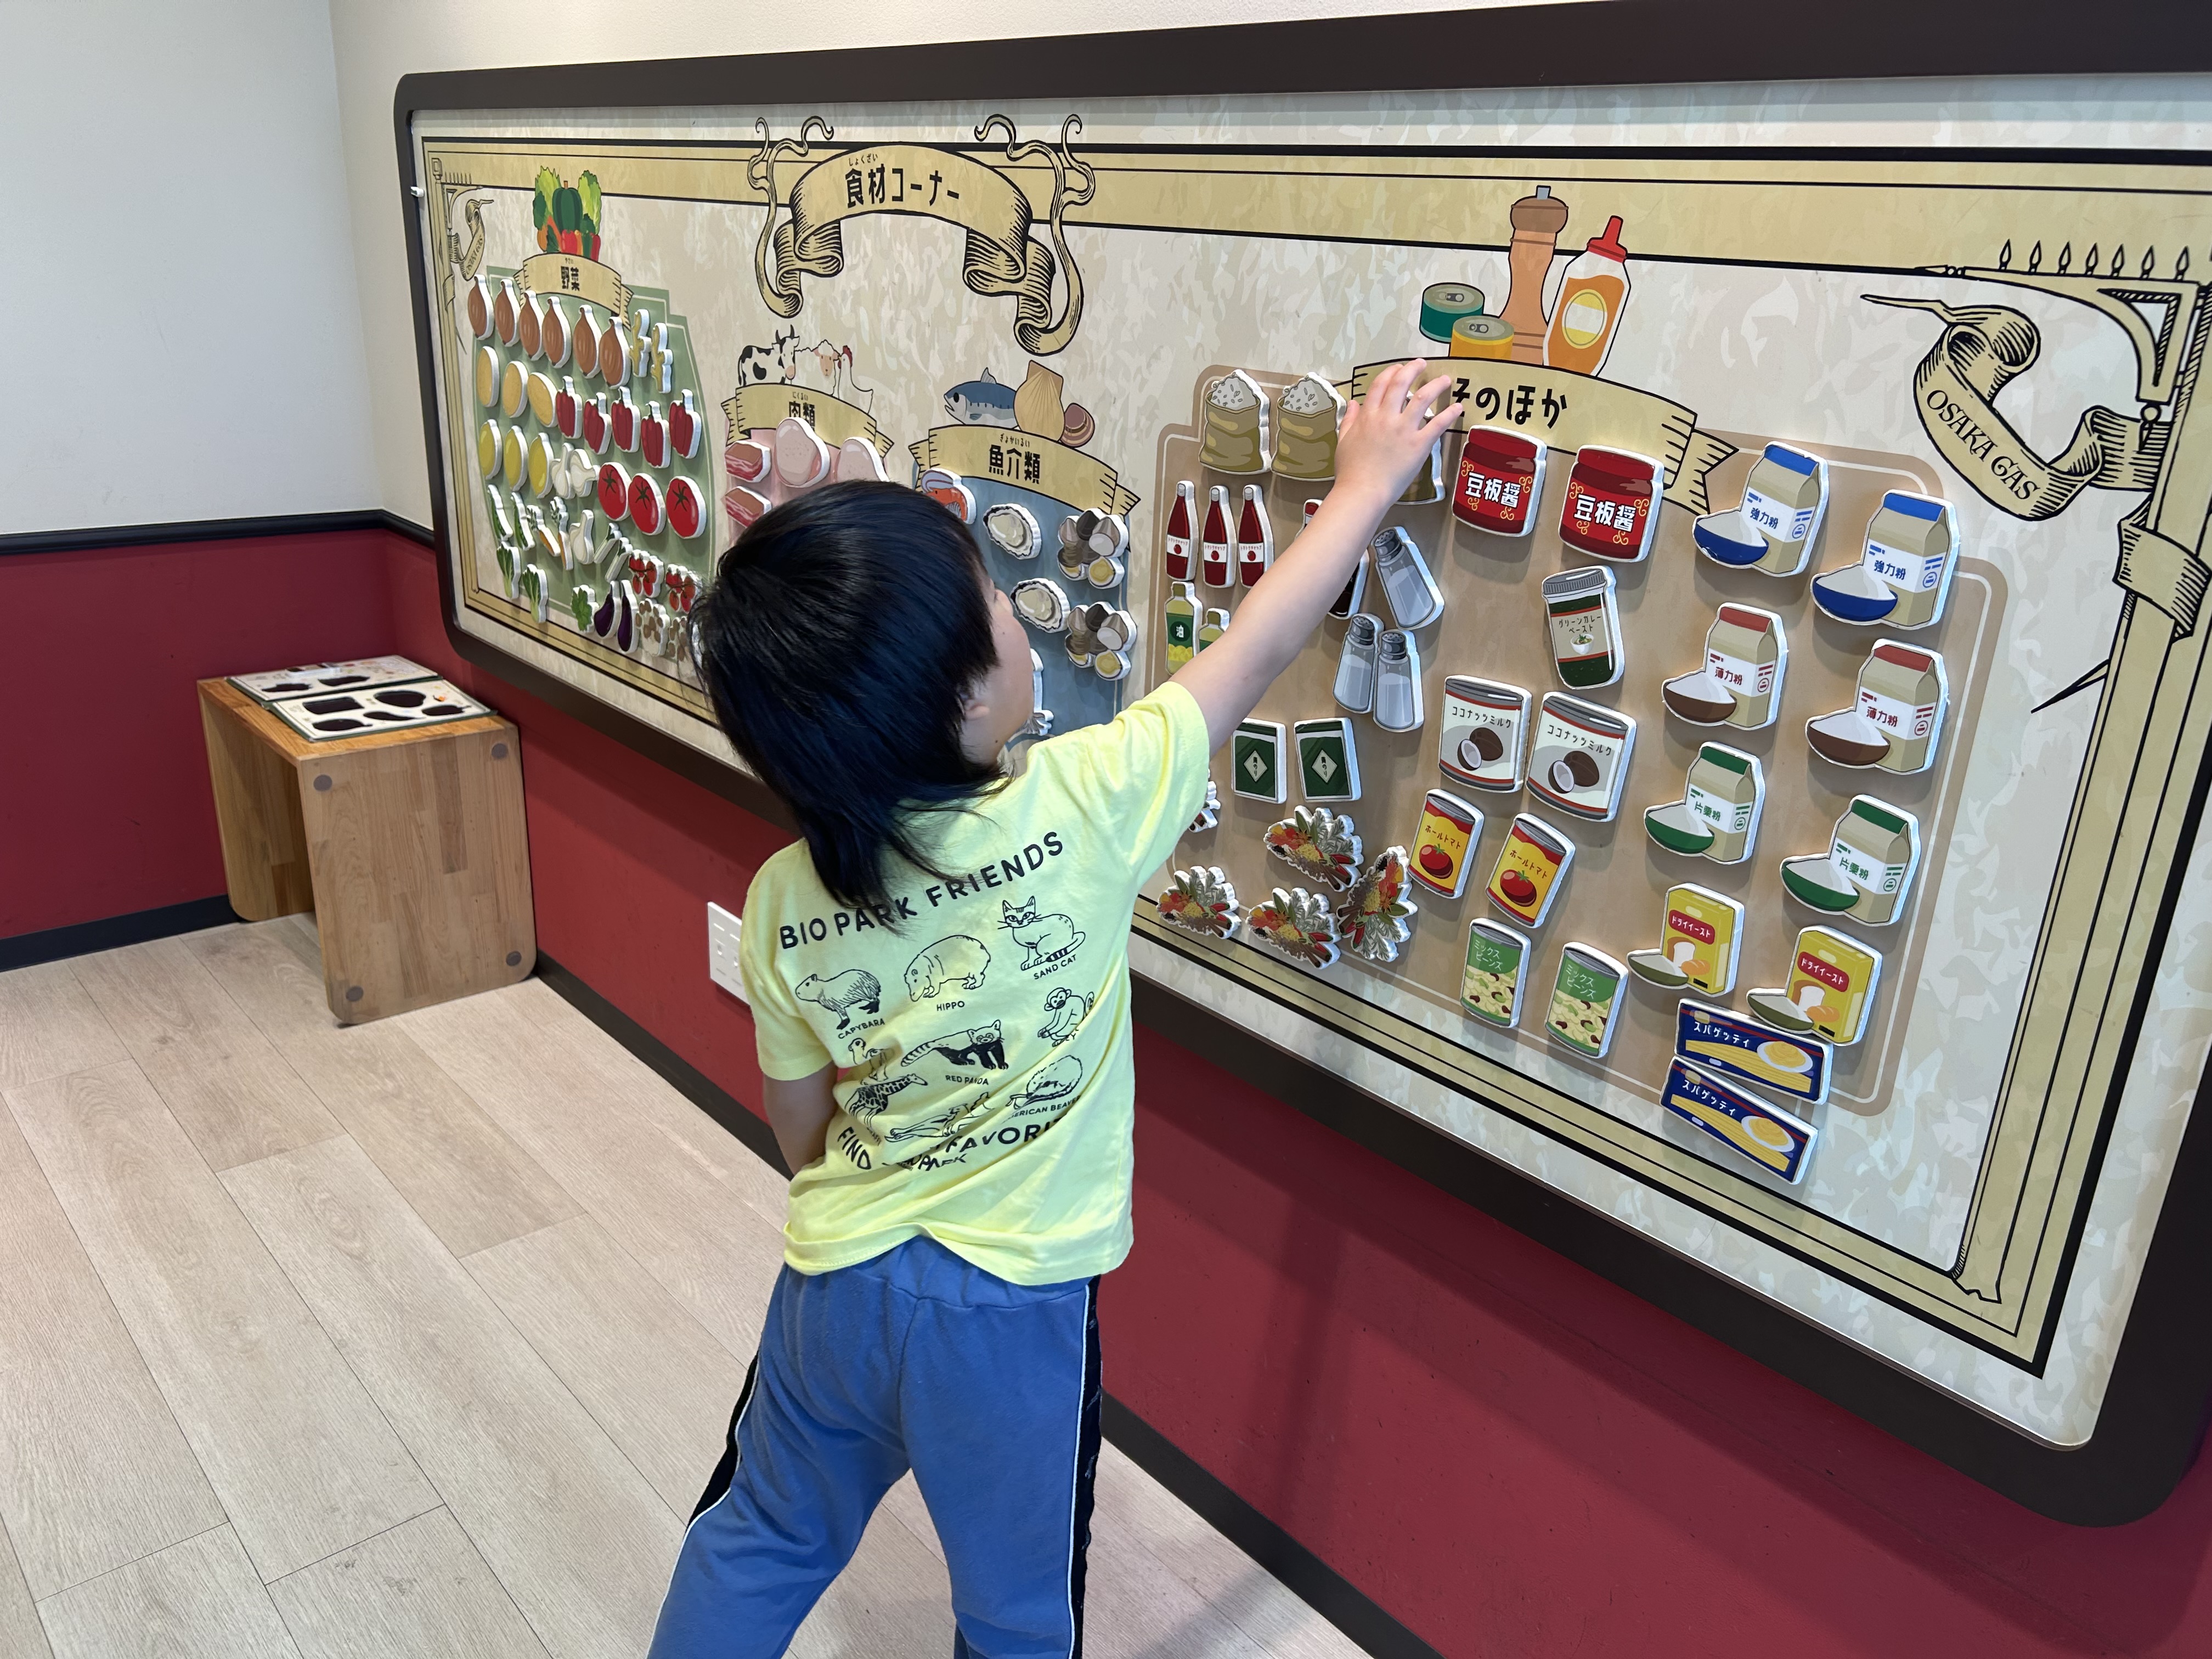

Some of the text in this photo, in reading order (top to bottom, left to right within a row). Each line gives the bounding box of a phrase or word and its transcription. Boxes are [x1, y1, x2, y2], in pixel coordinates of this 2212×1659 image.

[849, 153, 878, 166] しょくざい
[845, 163, 959, 208] 食材コーナー
[561, 266, 580, 291] 野菜
[1452, 377, 1567, 429] そのほか
[1000, 433, 1030, 448] ぎょかいるい
[1927, 390, 2040, 500] OSAKA GAS
[989, 444, 1040, 484] 魚介類
[1465, 472, 1521, 508] 豆板醤
[1574, 494, 1636, 532] 豆板醤
[1750, 507, 1778, 529] 強力粉
[1874, 560, 1906, 580] 強力粉
[1176, 624, 1184, 638] 油
[1559, 615, 1601, 628] グリーンカレー
[1568, 624, 1593, 634] ペースト
[1714, 666, 1743, 685] 薄力粉
[1452, 706, 1511, 728] ココナッツミルク
[1866, 706, 1898, 727] 薄力粉
[1547, 724, 1612, 756] ココナッツミルク
[1694, 800, 1721, 822] 片栗粉
[1425, 825, 1461, 850] ホールトマト
[1510, 849, 1547, 879] ホールトマト
[1839, 857, 1869, 881] 片栗粉
[780, 831, 1063, 949] BIO PARK FRIENDS
[1672, 915, 1711, 939] ドライイースト
[1474, 939, 1500, 960] ミックス
[1476, 950, 1503, 971] ビーンズ
[1034, 955, 1077, 979] SAND CAT
[1566, 964, 1594, 988] ミックス
[1801, 957, 1844, 985] ドライイースト
[1567, 977, 1596, 1000] ビーンズ
[936, 1001, 965, 1011] HIPPO
[838, 1018, 885, 1039] CAPYBARA
[1694, 1021, 1750, 1048] スパゲッティ
[946, 1075, 989, 1086] RED PANDA
[1682, 1080, 1736, 1116] スパゲッティ
[837, 1126, 872, 1170] FIND
